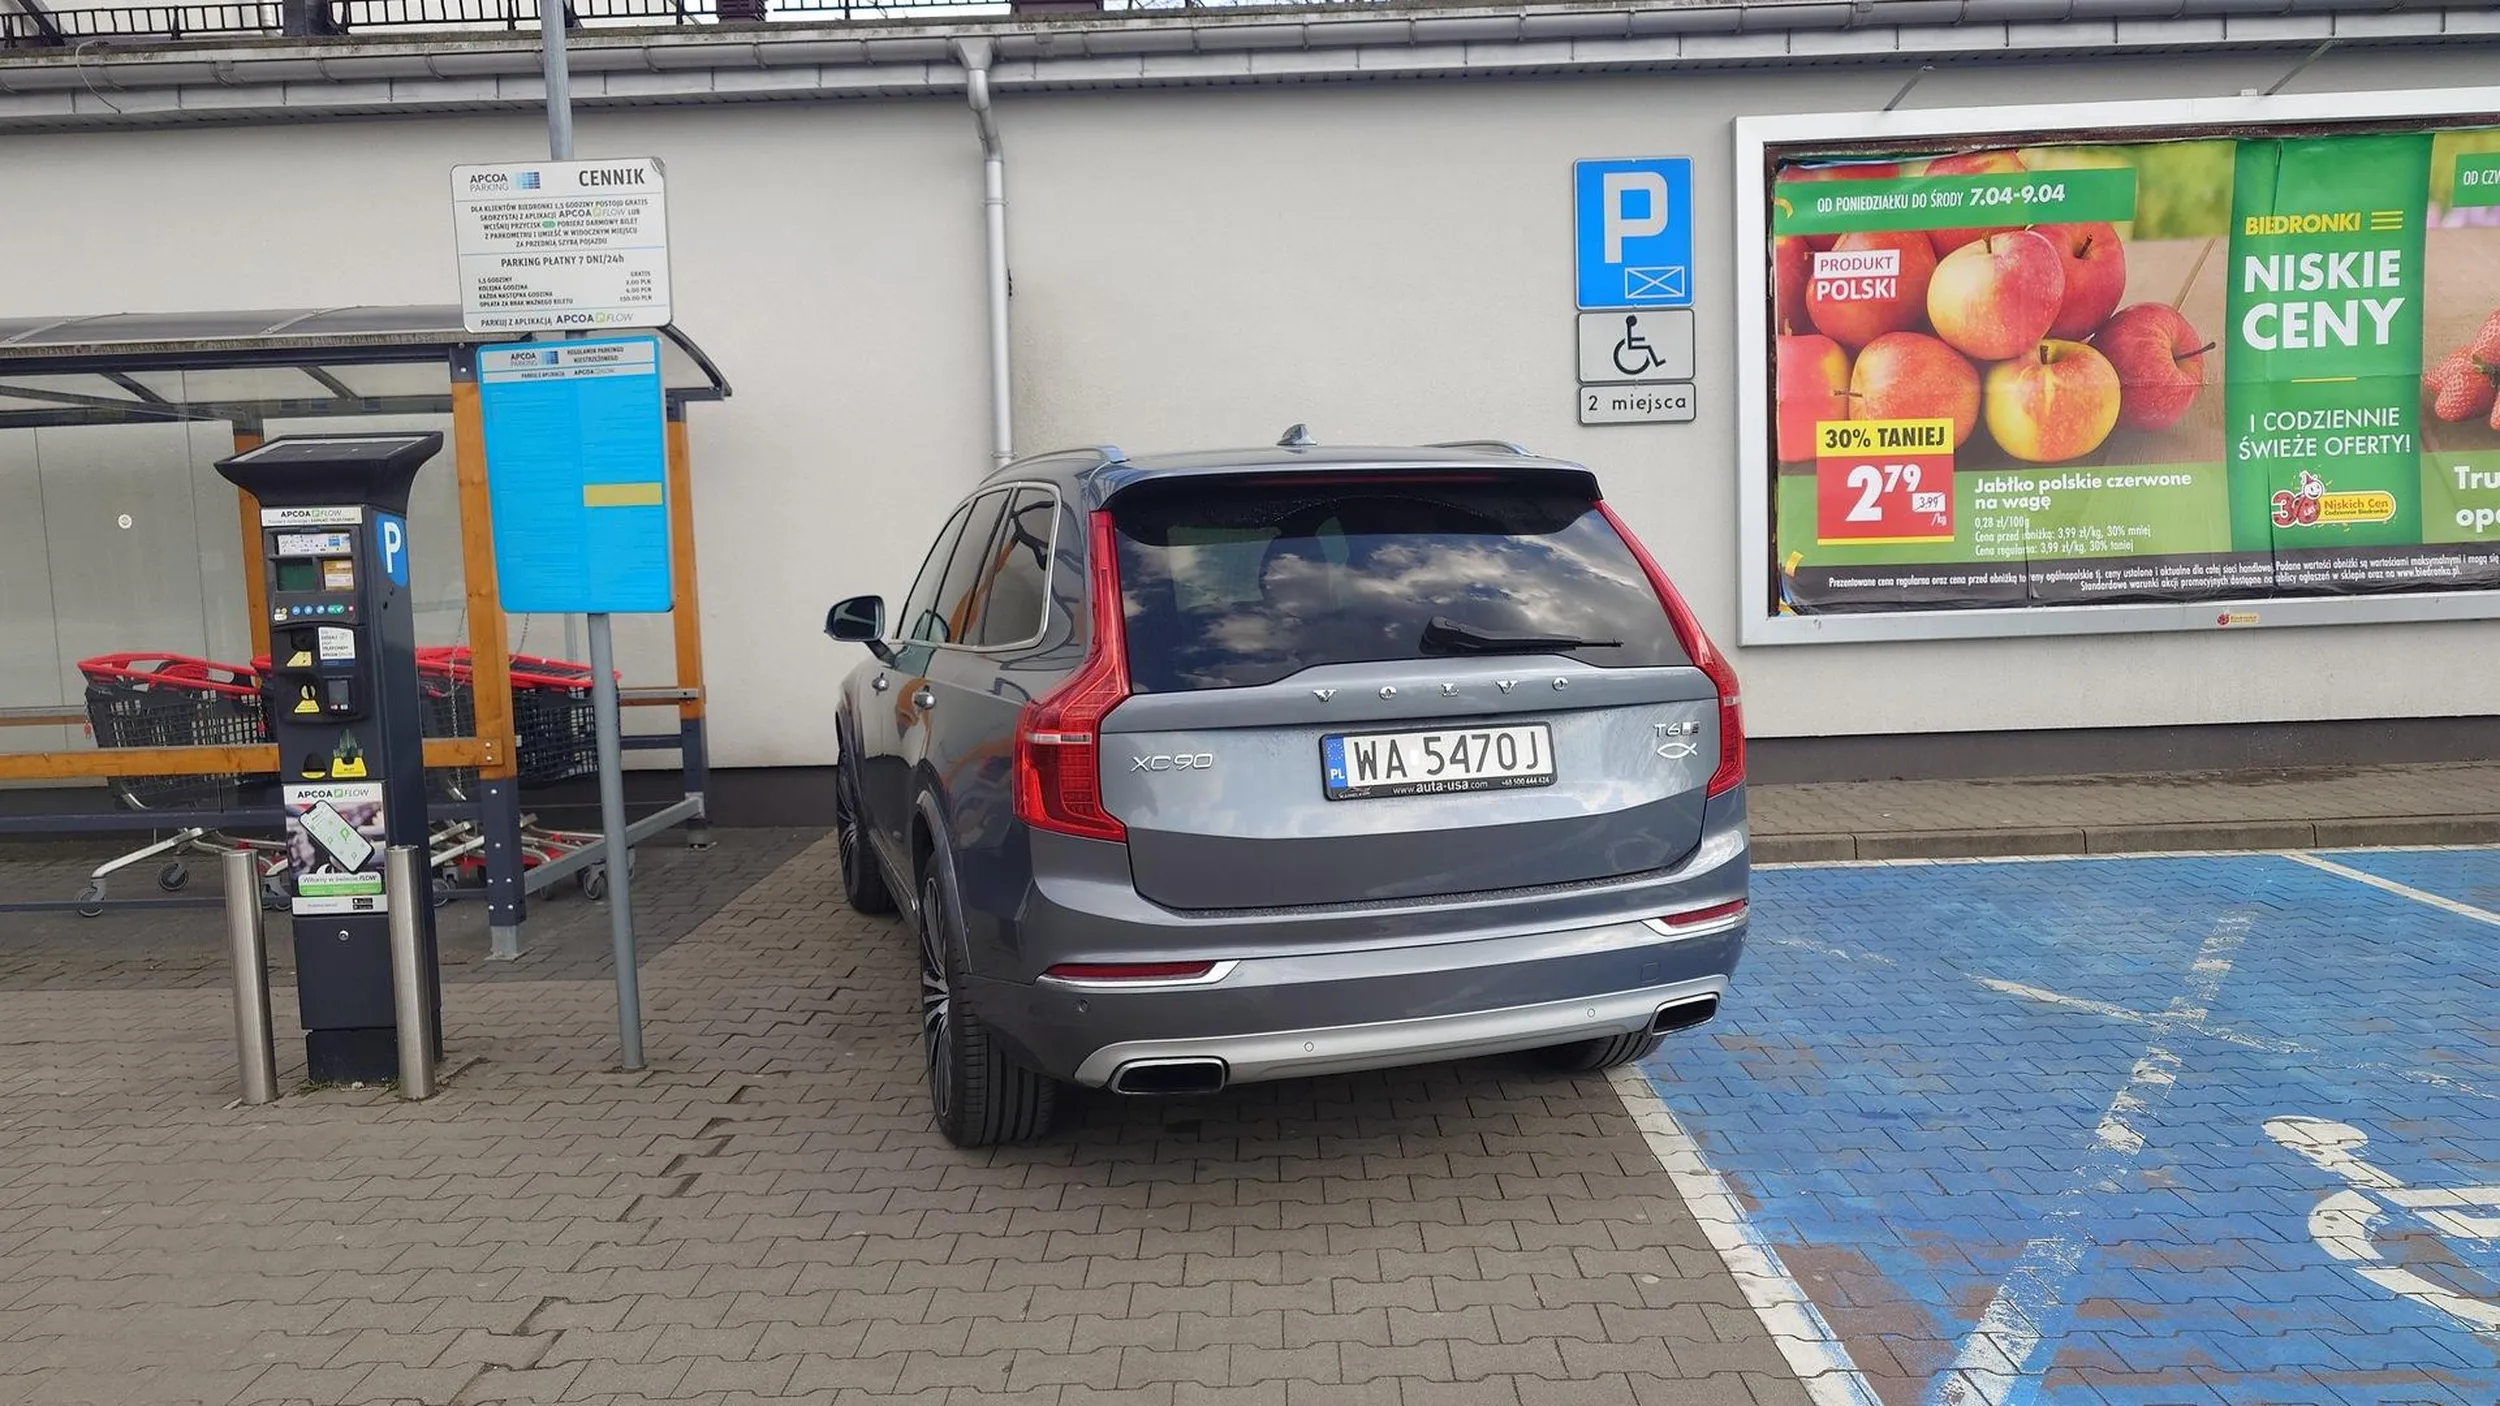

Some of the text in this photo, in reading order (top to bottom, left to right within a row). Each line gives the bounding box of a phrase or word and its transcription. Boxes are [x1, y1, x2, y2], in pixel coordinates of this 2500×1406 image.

[470, 173, 508, 183] APCOA
[579, 168, 645, 187] CENNIK
[2464, 170, 2478, 185] OD
[470, 183, 509, 192] PARKING
[484, 203, 516, 212] KLIENTÓW
[518, 202, 553, 211] BIEDRONKI
[565, 201, 594, 209] GODZINY
[595, 200, 624, 208] POSTOJU
[1817, 184, 2065, 213] OD PONIEDZIAŁKU DO ŚRODY 7.04-9.04
[480, 213, 519, 222] SKORZYSTAJ
[559, 209, 592, 218] APCOA
[603, 208, 626, 216] FLOW
[1603, 171, 1668, 263] P
[2245, 212, 2361, 236] BIEDRONKI
[483, 222, 510, 231] WCIŚNIJ
[511, 221, 541, 230] PRZYCISK
[586, 218, 619, 226] DARMOWY
[490, 231, 532, 240] PARKOMETRU
[570, 228, 610, 236] WIDOCZNYM
[611, 227, 637, 235] MIEJSCU
[525, 239, 557, 247] PRZEDNIĄ
[558, 239, 579, 247] SZYBĄ
[501, 254, 625, 267] PARKING PŁATNY 7 DNI/24h
[1820, 255, 1894, 272] PRODUKT
[2244, 250, 2401, 292] NISKIE
[1816, 278, 1896, 301] POLSKI
[481, 319, 508, 327] PARKUJ
[514, 317, 553, 326] APLIKACJĄ
[556, 313, 595, 324] APCOA
[606, 312, 634, 323] FLOW
[2242, 297, 2406, 350] CENY
[511, 352, 536, 361] APCOA
[1588, 394, 1687, 415] 2 miejsca
[2250, 407, 2400, 433] I CODZIENNIE
[1825, 426, 1945, 449] 30% TANIEJ
[2238, 433, 2411, 460] ŚWIEŻE OFERTY!
[1974, 472, 2193, 494] Jabłko polskie czerwone
[1975, 495, 2052, 511] na wagę
[2324, 498, 2389, 509] Niskich Cen
[281, 509, 342, 518] APCOA FLOW
[1974, 516, 1994, 530] 0,28
[1975, 530, 1994, 543] Cena
[1997, 529, 2020, 544] przed
[2022, 527, 2055, 541] bniżką:
[2058, 526, 2076, 540] 3,99
[2107, 525, 2126, 537] 30%
[2128, 524, 2151, 538] mniej
[383, 521, 401, 574] P
[1975, 544, 1994, 557] Cena
[2040, 541, 2059, 555] 3,99
[2089, 539, 2108, 552] 30%
[2110, 539, 2134, 553] taniej
[1829, 575, 1876, 588] Prezentowane
[1878, 577, 1894, 587] cena
[1896, 575, 1930, 588] regularna
[1932, 576, 1948, 586] oraz
[1950, 576, 1966, 585] cena
[1968, 573, 1988, 586] przed
[1990, 572, 2017, 586] obniżką
[2019, 573, 2027, 583] to
[2046, 568, 2094, 584] ogólnopolskie
[2105, 570, 2121, 581] ceny
[2123, 566, 2153, 578] ustalone
[2160, 564, 2191, 576] aktualne
[2192, 564, 2204, 575] dla
[2205, 561, 2222, 576] całej
[2223, 563, 2238, 574] sieci
[2276, 560, 2301, 571] Podane
[2303, 558, 2332, 570] wartości
[2333, 557, 2359, 569] obniżki
[2360, 560, 2368, 570] są
[2369, 556, 2409, 568] wartościami
[2410, 553, 2462, 567] maksymalnymi
[2468, 555, 2488, 567] mogą
[2489, 553, 2500, 565] się
[2080, 579, 2128, 592] Standardowe
[2129, 578, 2160, 589] warunki
[2161, 577, 2179, 590] akcji
[2181, 576, 2229, 589] promocyjnych
[2230, 574, 2262, 587] dostępne
[2264, 576, 2273, 584] na
[2276, 573, 2297, 587] ablicy
[2299, 571, 2331, 584] ogłoszeń
[2333, 572, 2339, 580] w
[2341, 569, 2366, 582] sklepie
[2368, 571, 2384, 580] oraz
[2386, 570, 2395, 579] na
[1313, 677, 1569, 702] VOLVO
[1653, 723, 1681, 737] T6
[1130, 753, 1213, 772] XC90
[1331, 730, 1538, 782] PL WA 5470J
[297, 789, 370, 799] APCOA FLOW
